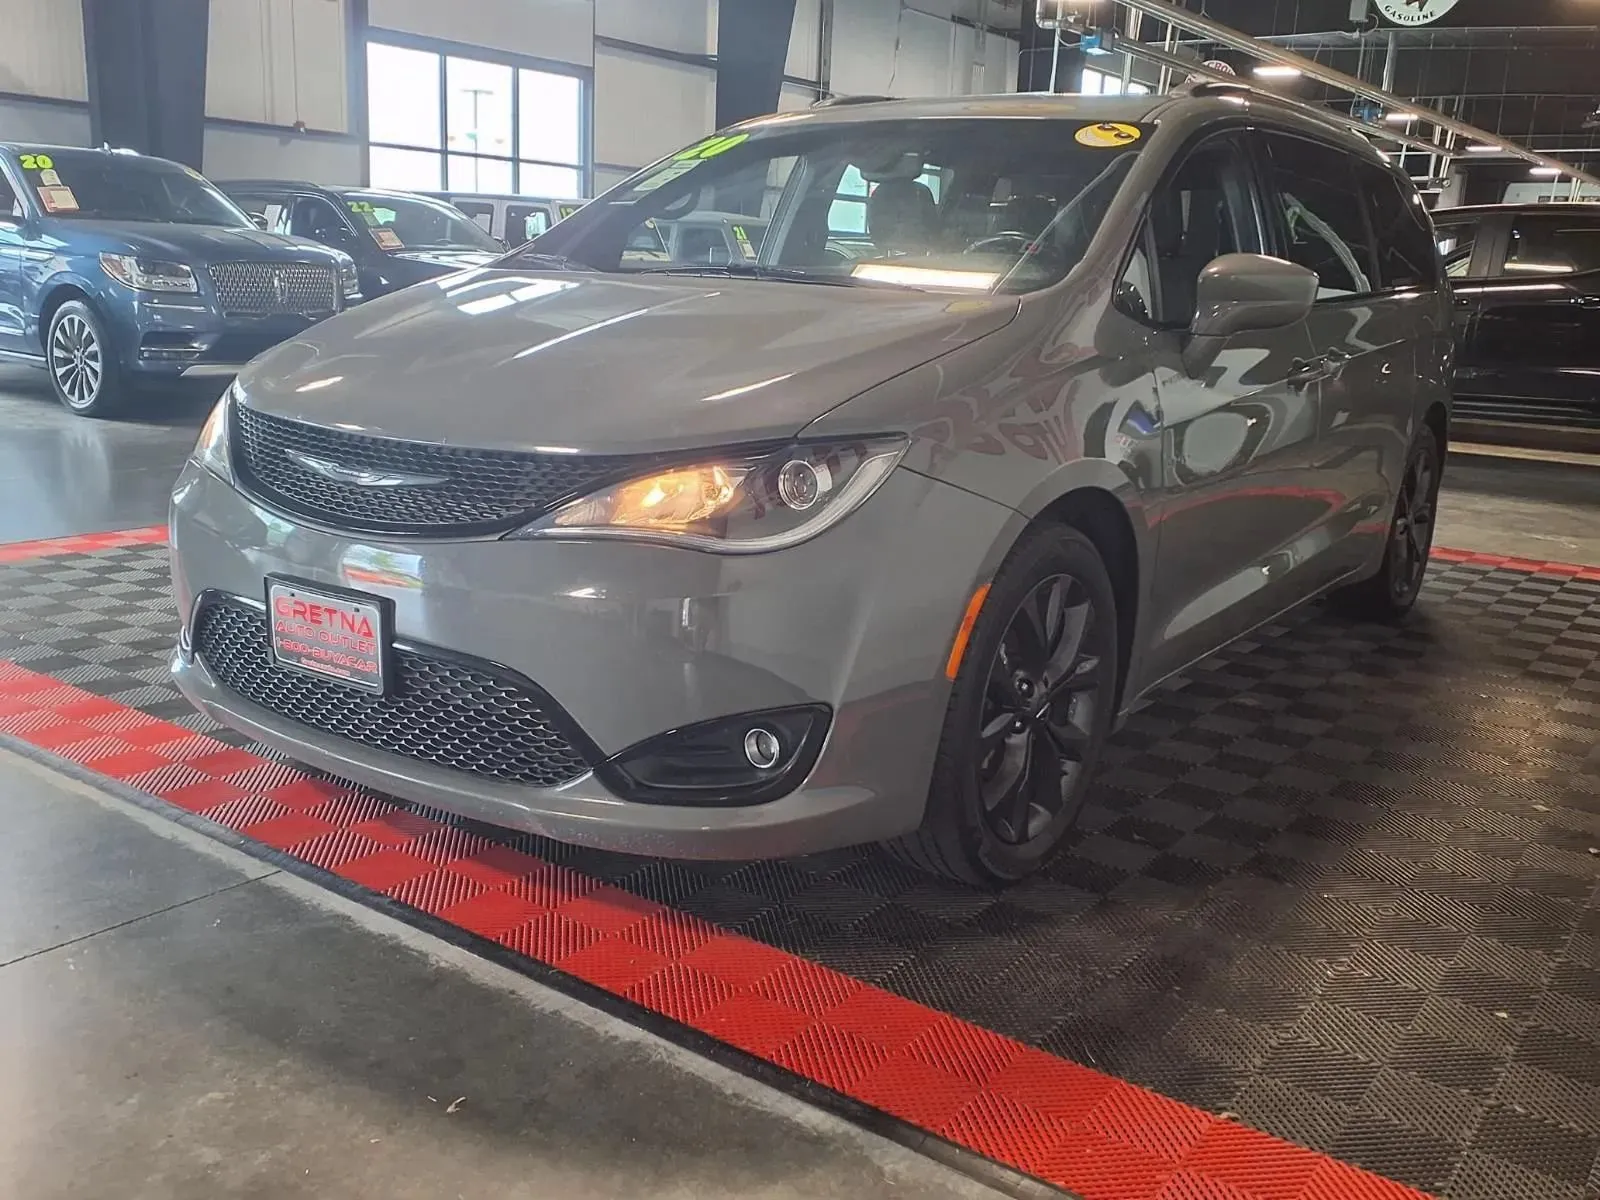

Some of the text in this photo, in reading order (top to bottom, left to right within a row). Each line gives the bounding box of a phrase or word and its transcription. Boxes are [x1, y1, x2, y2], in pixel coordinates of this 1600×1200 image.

[1384, 4, 1434, 22] GASOLINE
[19, 154, 54, 169] 20
[347, 201, 374, 213] 22
[732, 225, 748, 240] 21
[275, 596, 375, 638] GRETNA
[275, 620, 377, 656] AUTO OUTLET
